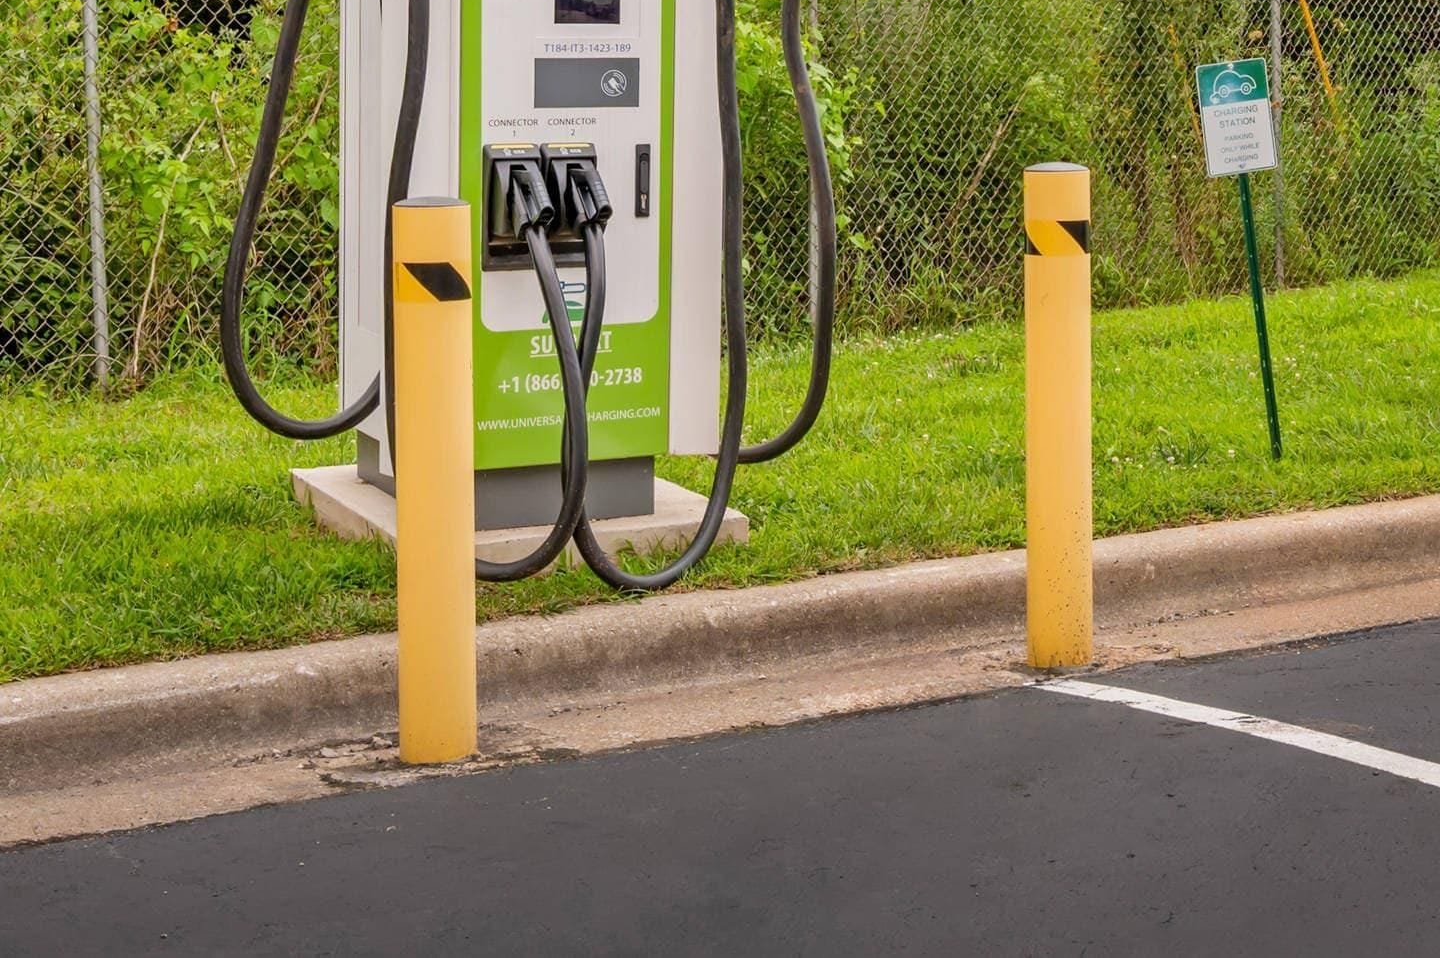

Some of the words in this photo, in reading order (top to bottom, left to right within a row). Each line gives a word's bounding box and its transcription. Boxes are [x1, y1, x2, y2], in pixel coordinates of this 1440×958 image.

[1214, 105, 1258, 117] CHARGING
[488, 118, 539, 127] CONNECTOR
[547, 117, 597, 126] CONNECTOR
[1219, 117, 1255, 128] STATION
[498, 375, 519, 394] +1
[591, 367, 643, 387] 0-2738
[477, 406, 661, 432] WWW.UNIVERSAHARGING.COM
